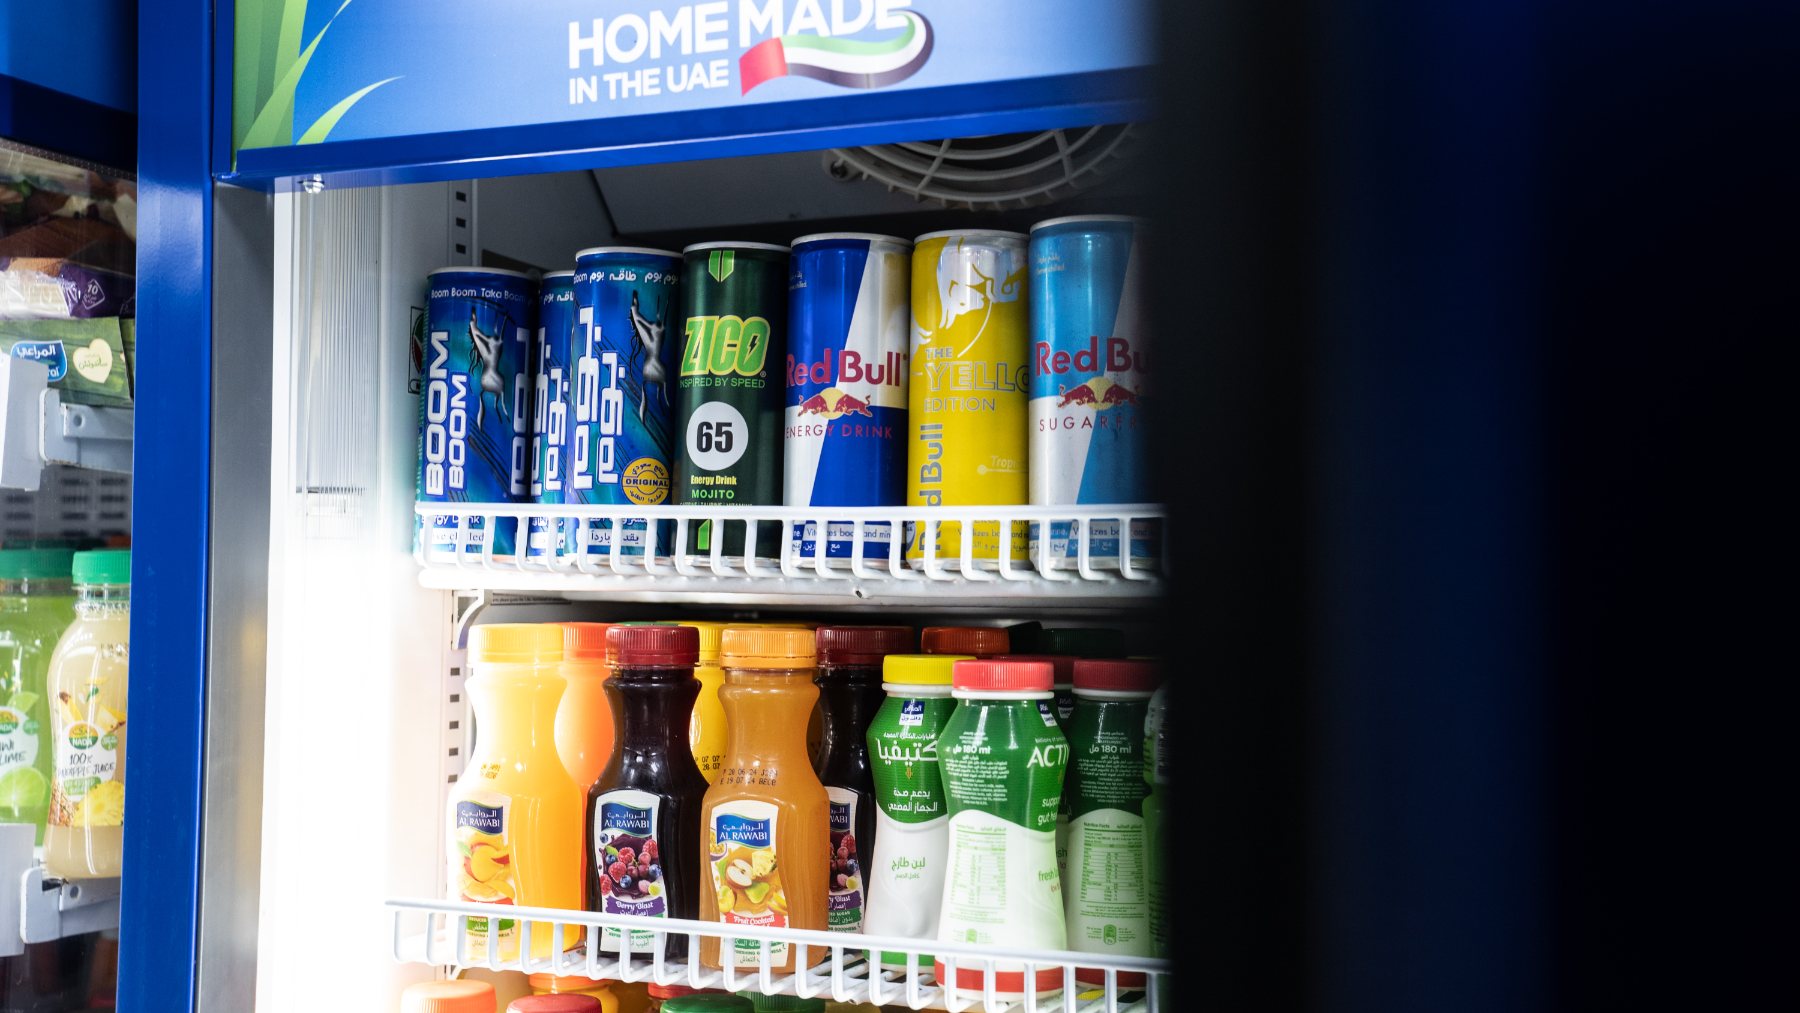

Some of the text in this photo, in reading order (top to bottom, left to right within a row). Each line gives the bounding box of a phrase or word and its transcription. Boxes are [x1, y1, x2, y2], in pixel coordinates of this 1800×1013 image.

[569, 1, 728, 69] HOME
[569, 59, 728, 104] IN THE UAE
[451, 287, 477, 297] Boom
[680, 315, 771, 377] ZICO
[925, 347, 953, 360] THE
[1035, 336, 1099, 377] Red
[786, 347, 901, 387] Red Bull
[715, 378, 729, 387] BY
[730, 377, 765, 389] SPEED
[924, 361, 1029, 393] YELLO
[924, 397, 996, 413] EDITION
[425, 331, 449, 495] BOOM
[448, 374, 467, 489] BOOM
[696, 421, 733, 453] 65
[786, 424, 893, 440] ENERGY DRINK
[920, 423, 944, 484] Bull
[625, 478, 668, 488] ORIGINAL
[690, 475, 737, 486] Energy Drink
[691, 489, 735, 499] MOJITO
[863, 529, 877, 538] and
[879, 529, 891, 538] min
[876, 738, 939, 767] كتيفيا
[963, 744, 991, 754] 180 ml
[1089, 744, 1100, 754] مل
[1101, 744, 1132, 754] 180 ml
[459, 816, 500, 828] AL RAWABI
[604, 819, 650, 829] AL RAWABI
[1037, 813, 1050, 826] gut
[720, 831, 768, 841] AL RAWABI
[891, 856, 926, 871] لبن طازج
